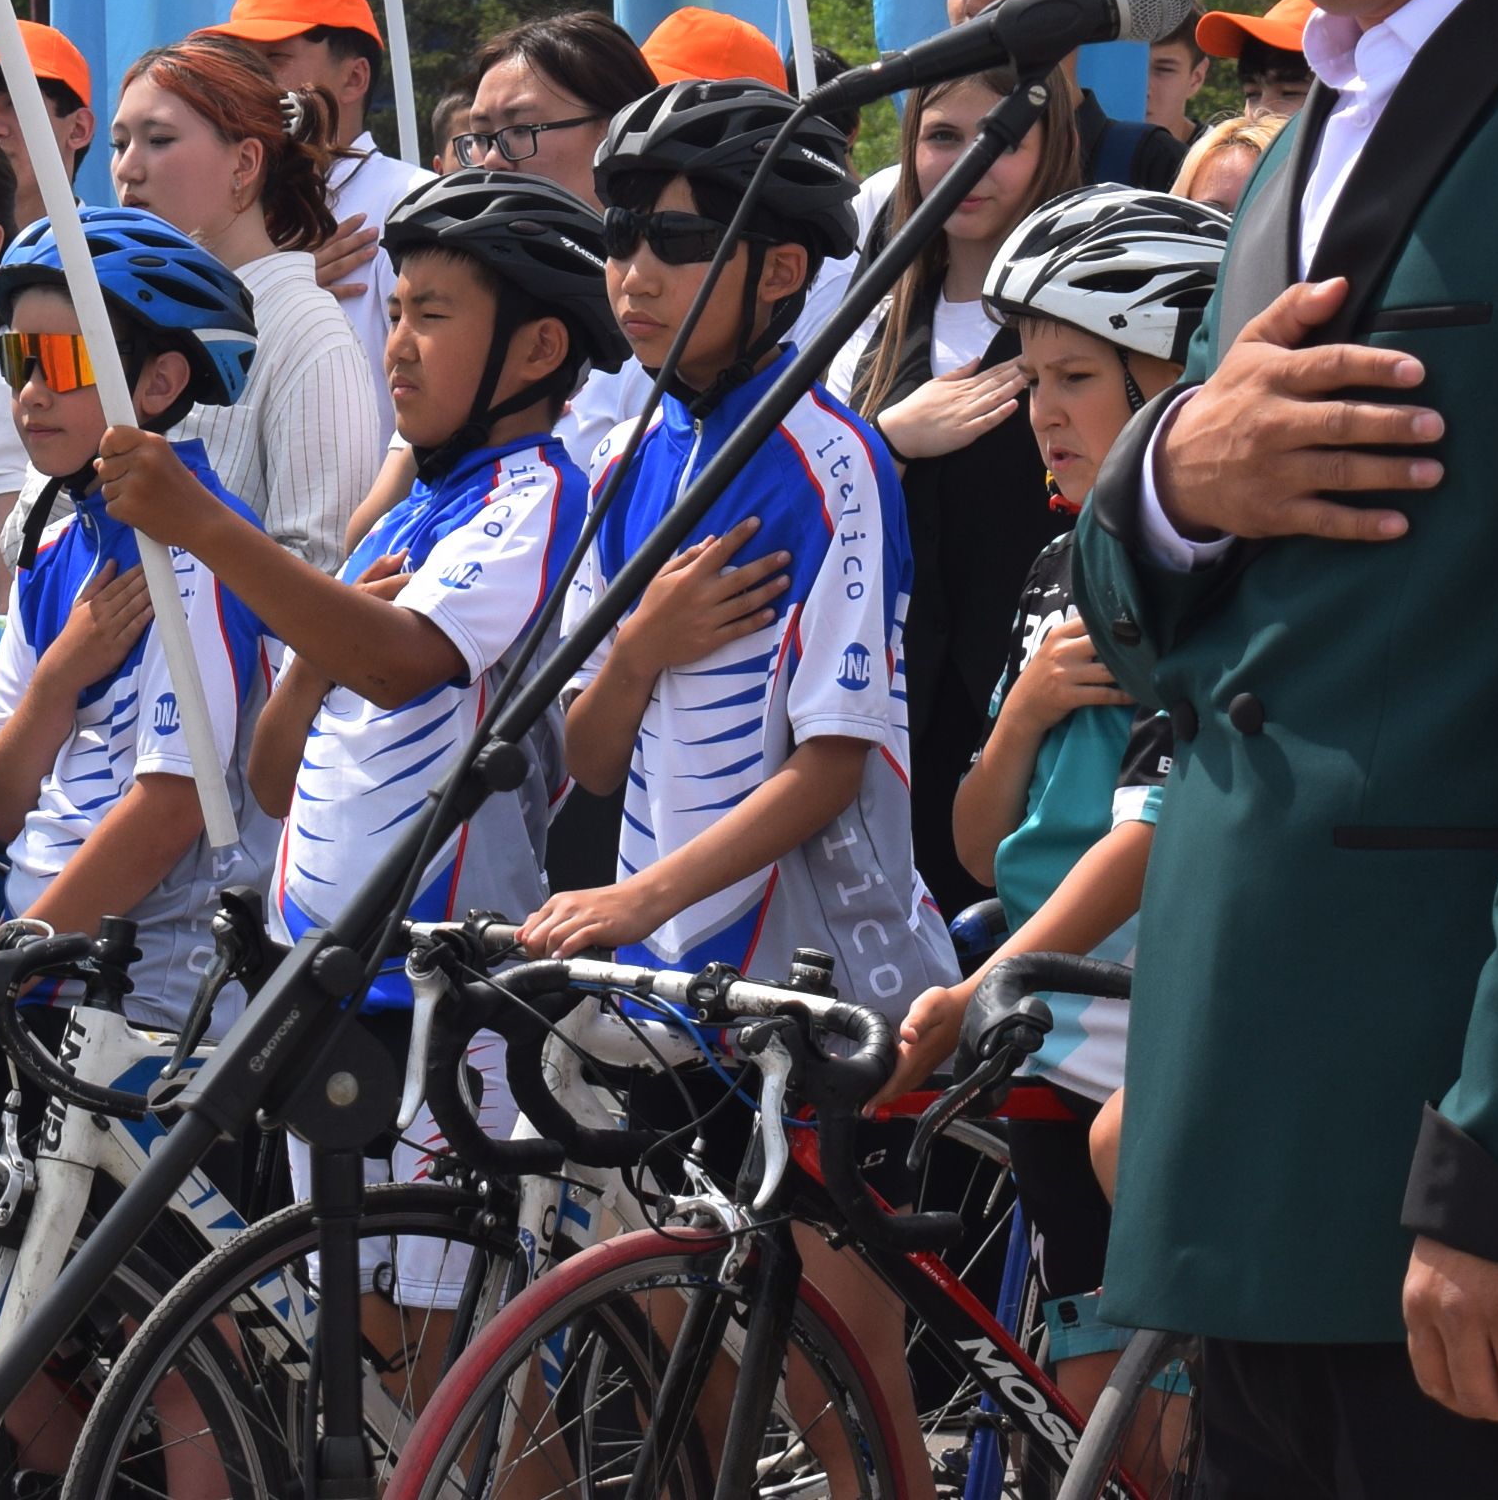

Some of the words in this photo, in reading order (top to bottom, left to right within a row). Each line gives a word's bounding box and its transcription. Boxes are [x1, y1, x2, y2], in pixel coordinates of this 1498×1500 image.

[816, 434, 867, 601] italico
[40, 1011, 87, 1153] GINT
[260, 1009, 300, 1059] BOYONG
